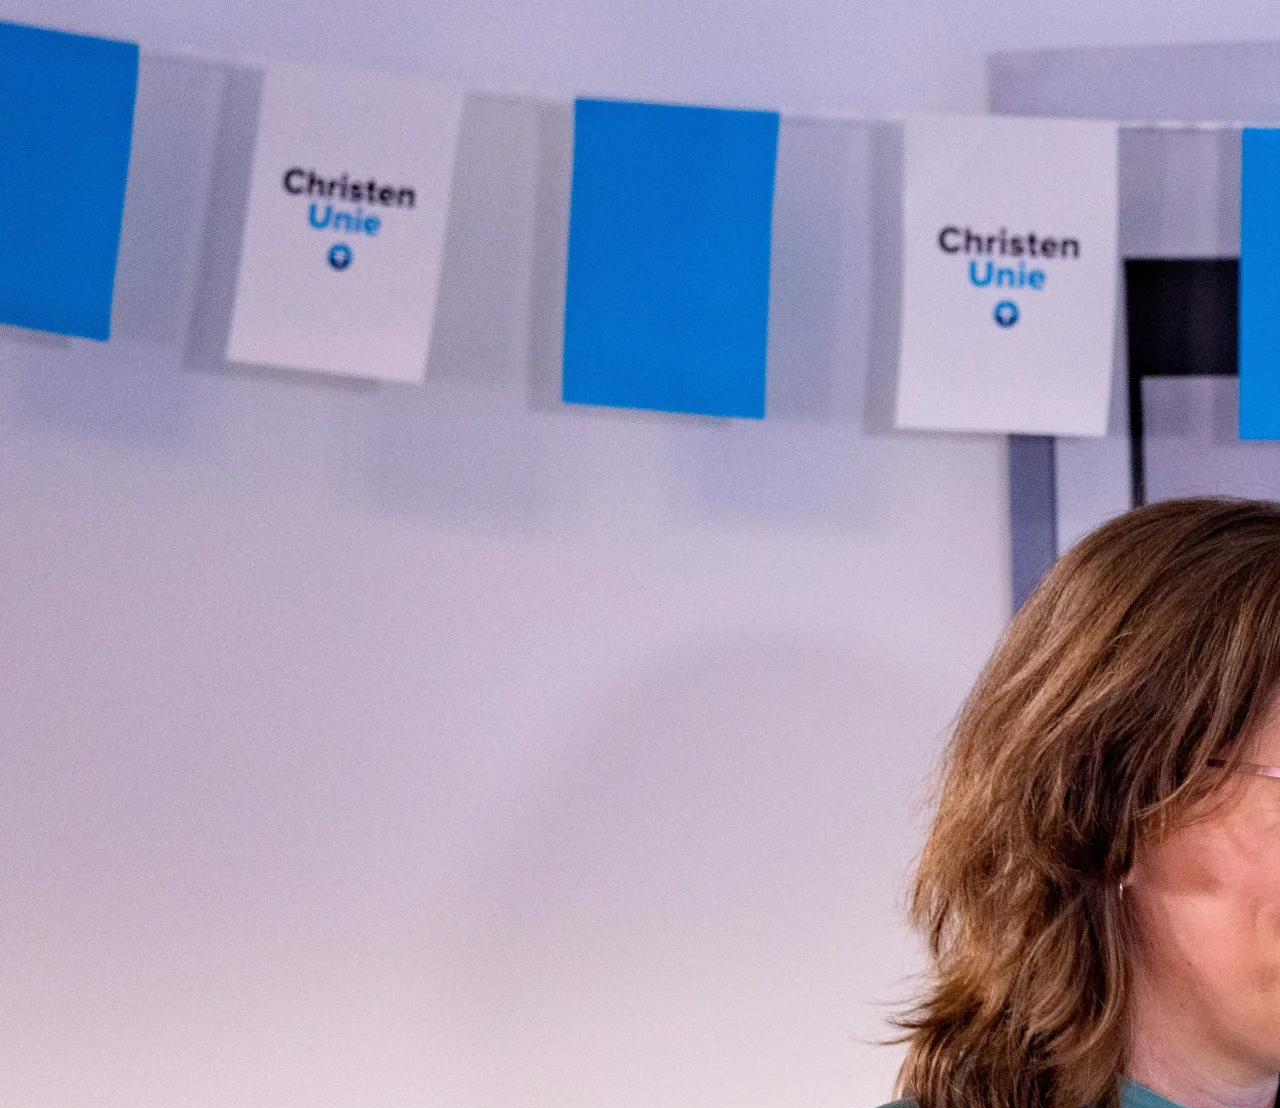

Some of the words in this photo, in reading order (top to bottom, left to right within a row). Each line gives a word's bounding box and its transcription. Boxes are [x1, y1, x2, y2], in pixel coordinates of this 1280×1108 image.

[283, 166, 417, 209] Christen
[307, 203, 381, 236] Unie
[938, 225, 1081, 258] Christen
[968, 259, 1047, 290] Unie
